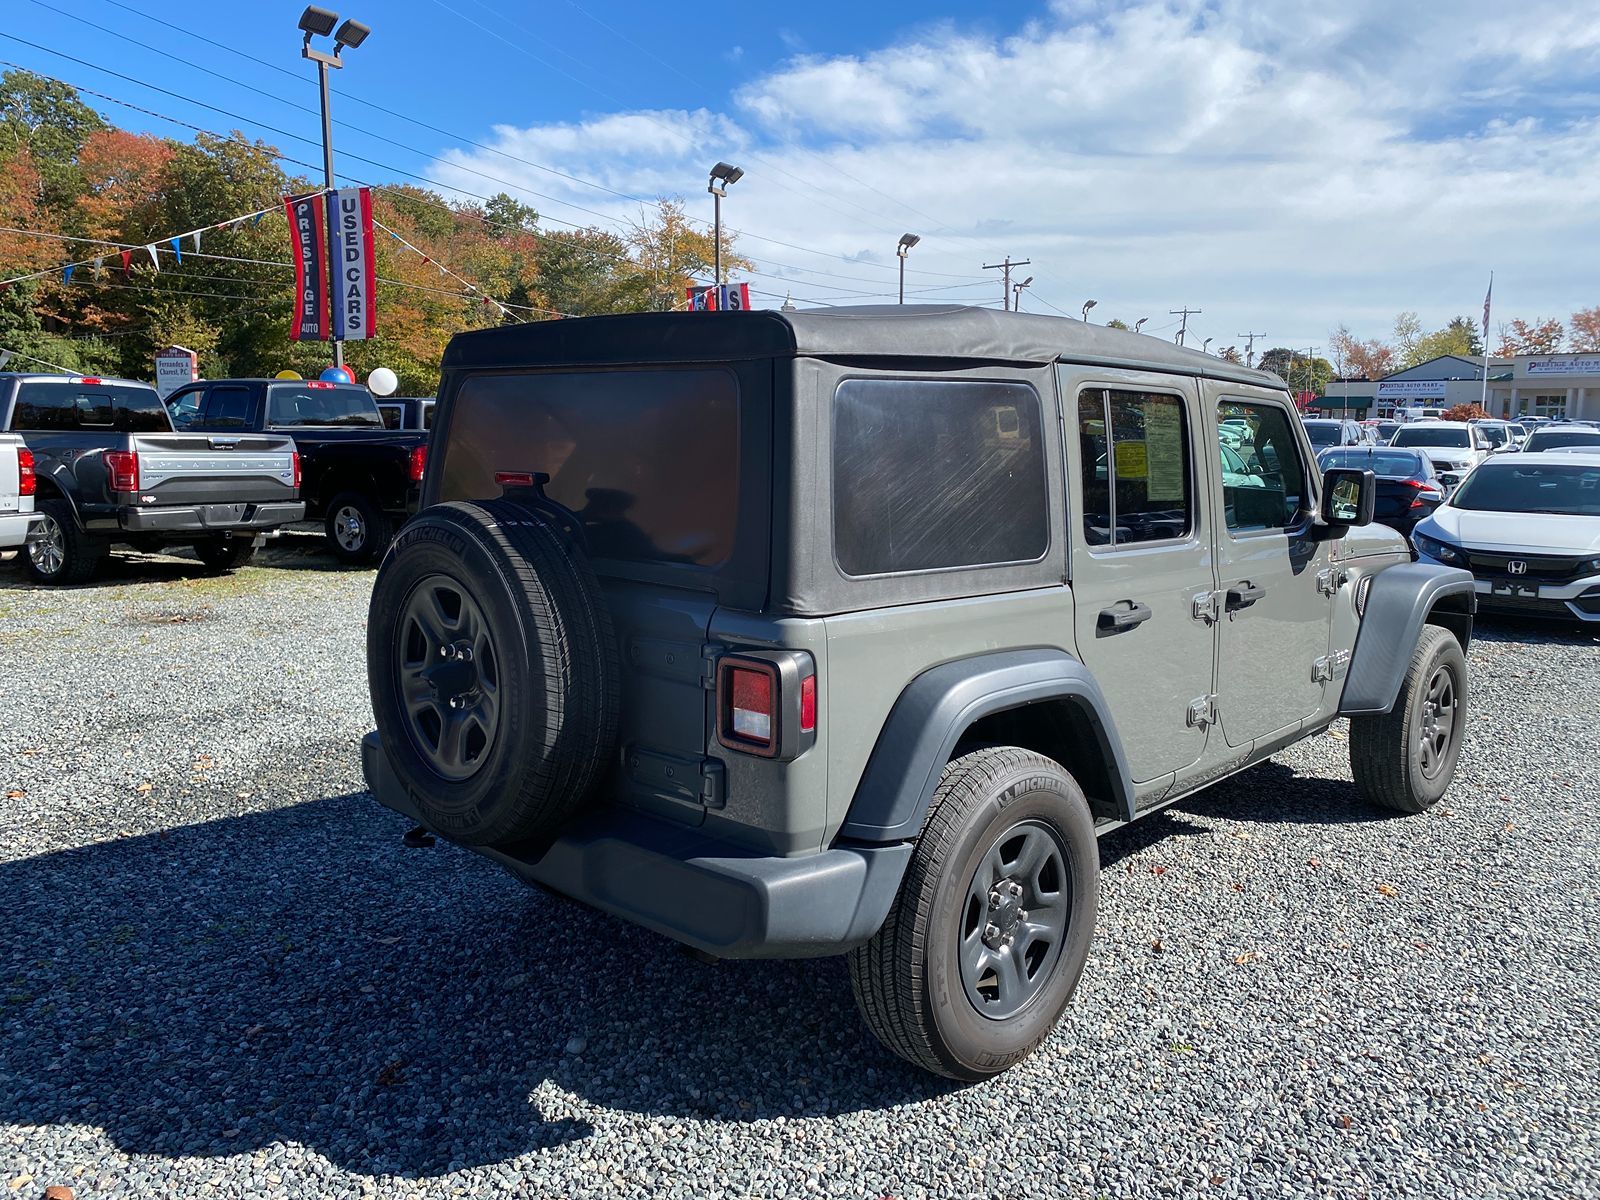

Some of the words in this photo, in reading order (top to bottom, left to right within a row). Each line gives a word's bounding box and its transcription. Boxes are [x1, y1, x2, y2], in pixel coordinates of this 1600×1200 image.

[341, 198, 360, 262] USED
[297, 203, 315, 316] PRESTIGE
[346, 267, 361, 330] CARS
[301, 323, 319, 333] AUTO
[158, 360, 184, 368] Fernandes
[1379, 383, 1405, 391] PRESTIGE
[408, 527, 465, 552] MICHELIN
[1015, 777, 1070, 801] MICHELIN
